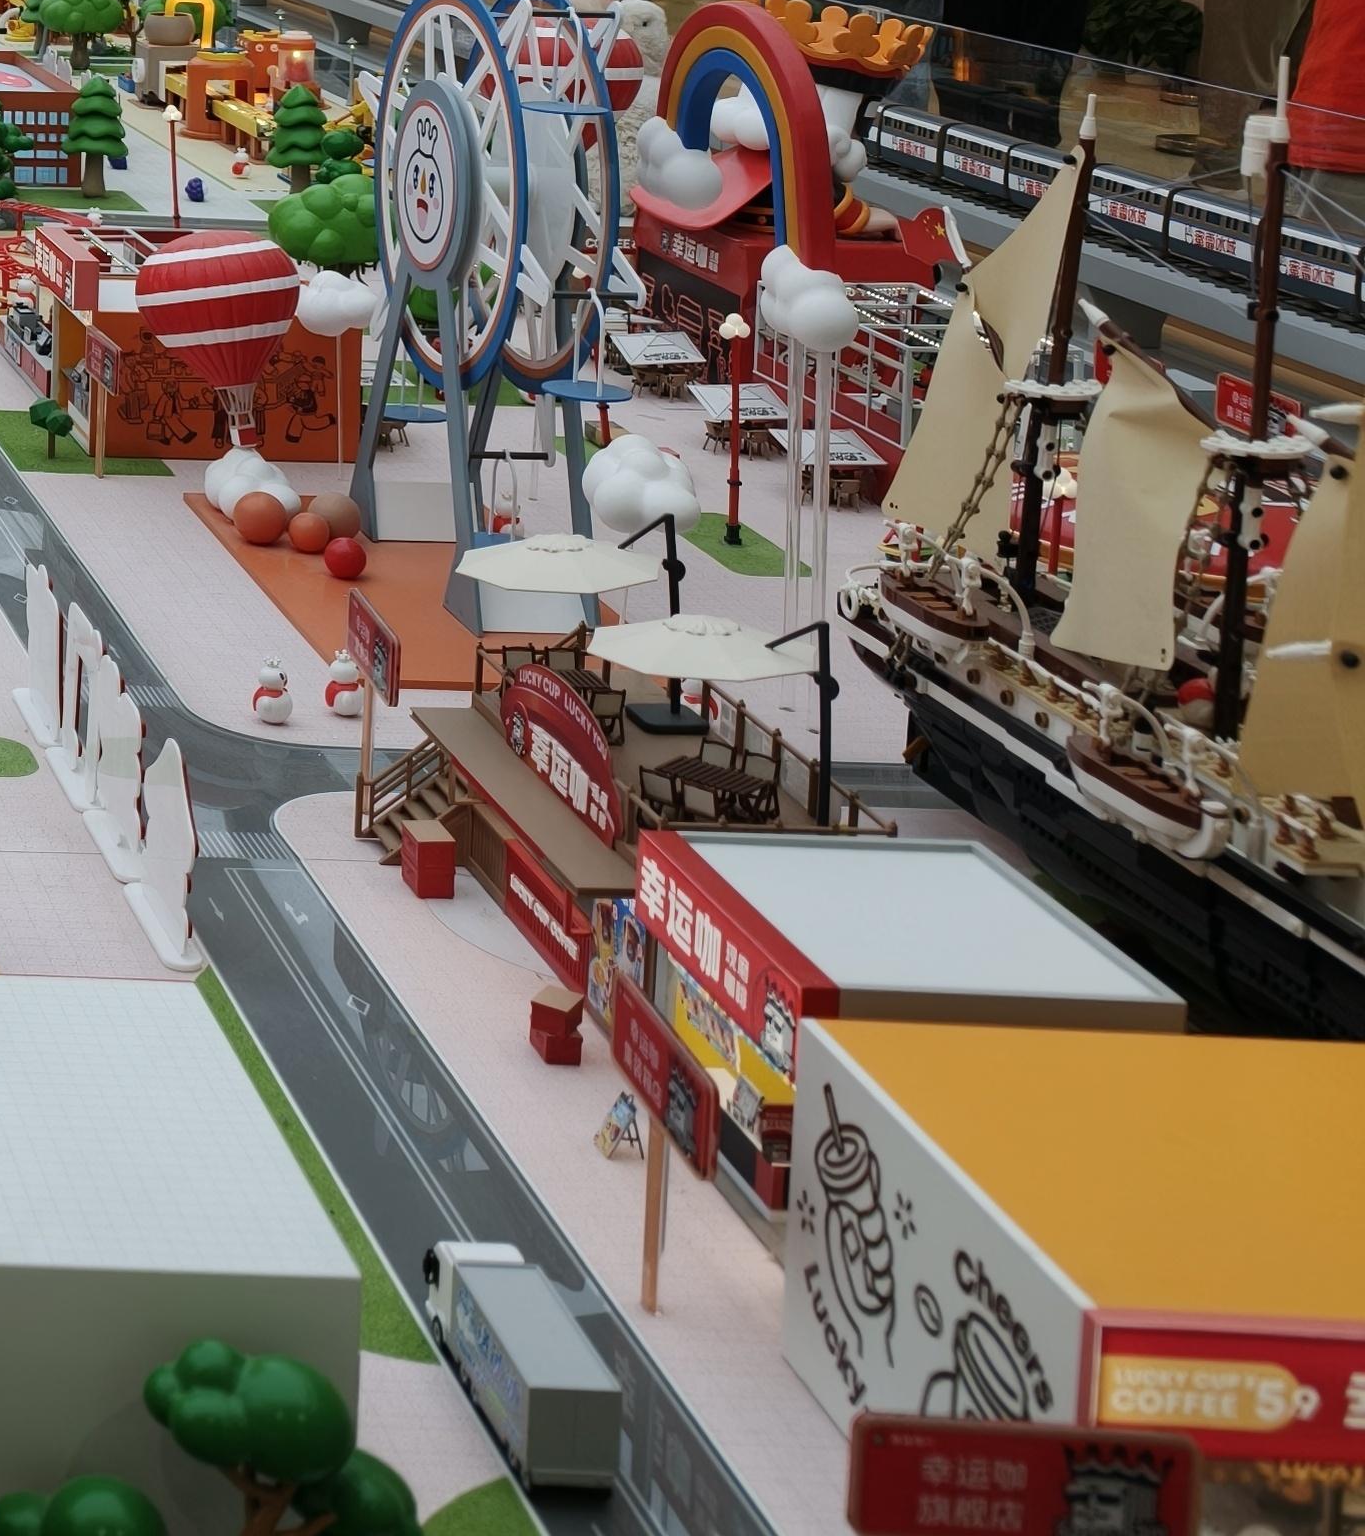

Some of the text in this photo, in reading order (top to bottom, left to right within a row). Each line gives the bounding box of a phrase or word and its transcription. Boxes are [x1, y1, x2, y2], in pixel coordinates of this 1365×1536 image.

[519, 669, 608, 761] LUCKY CUP LUCKY YOU
[529, 721, 589, 815] 幸运咖
[639, 855, 722, 983] 幸运咖
[803, 1260, 868, 1406] Lucky
[953, 1248, 1055, 1413] Cheers
[1109, 1387, 1239, 1419] COFFEE
[1112, 1366, 1190, 1386] LUCKY
[1192, 1369, 1241, 1391] CUP
